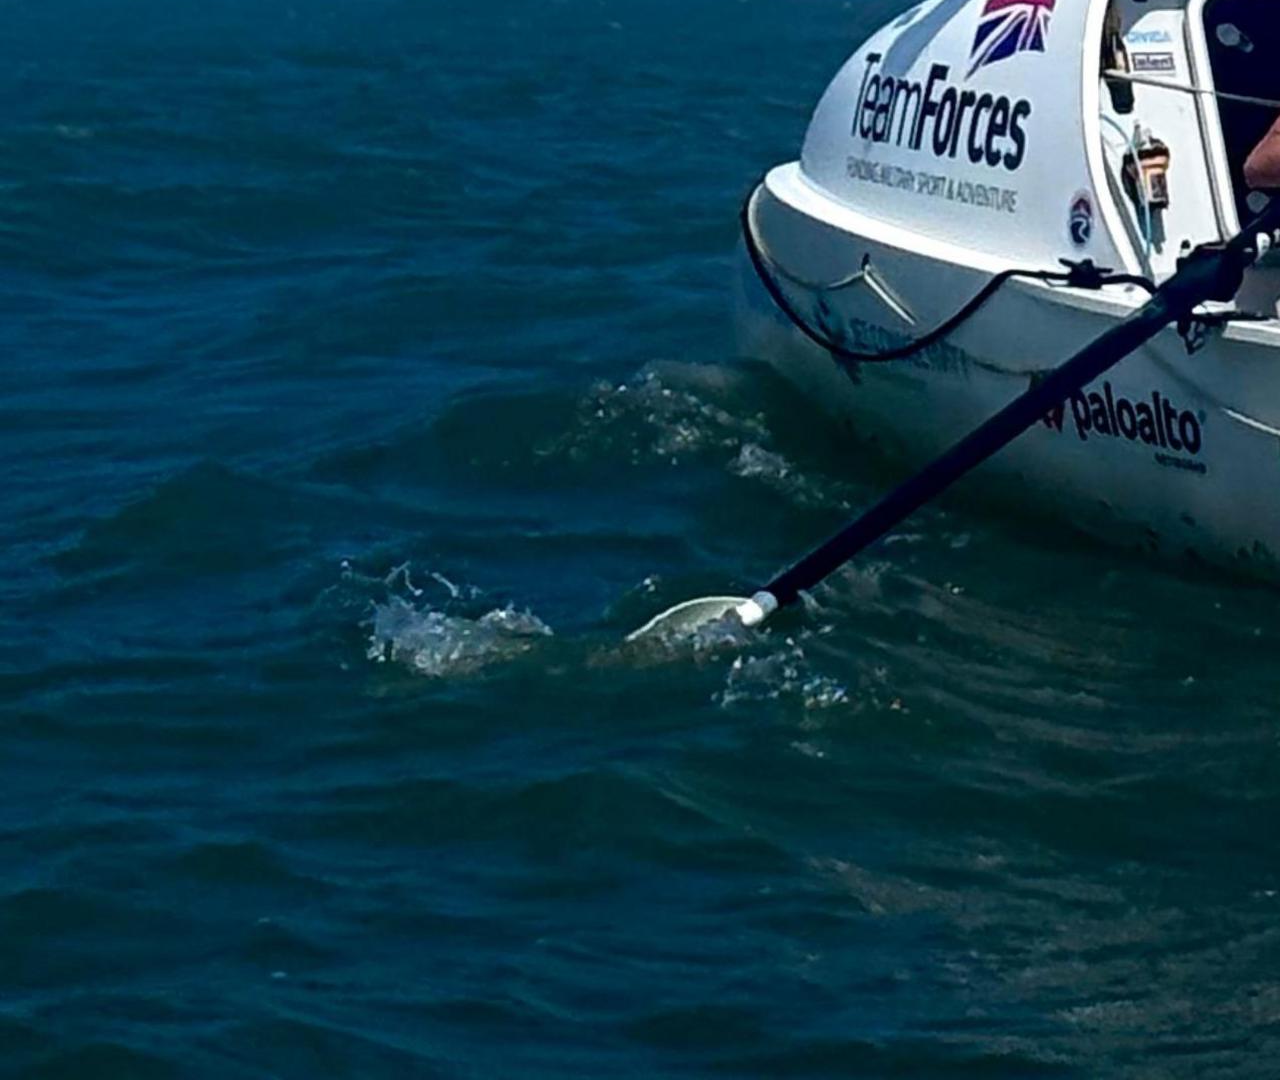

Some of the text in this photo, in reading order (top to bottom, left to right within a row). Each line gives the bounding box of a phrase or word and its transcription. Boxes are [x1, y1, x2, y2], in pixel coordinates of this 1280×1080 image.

[852, 52, 1032, 171] TeamForces
[916, 170, 946, 200] SPORT
[956, 182, 1019, 214] ADVENTURE
[1070, 380, 1202, 455] paloalto
